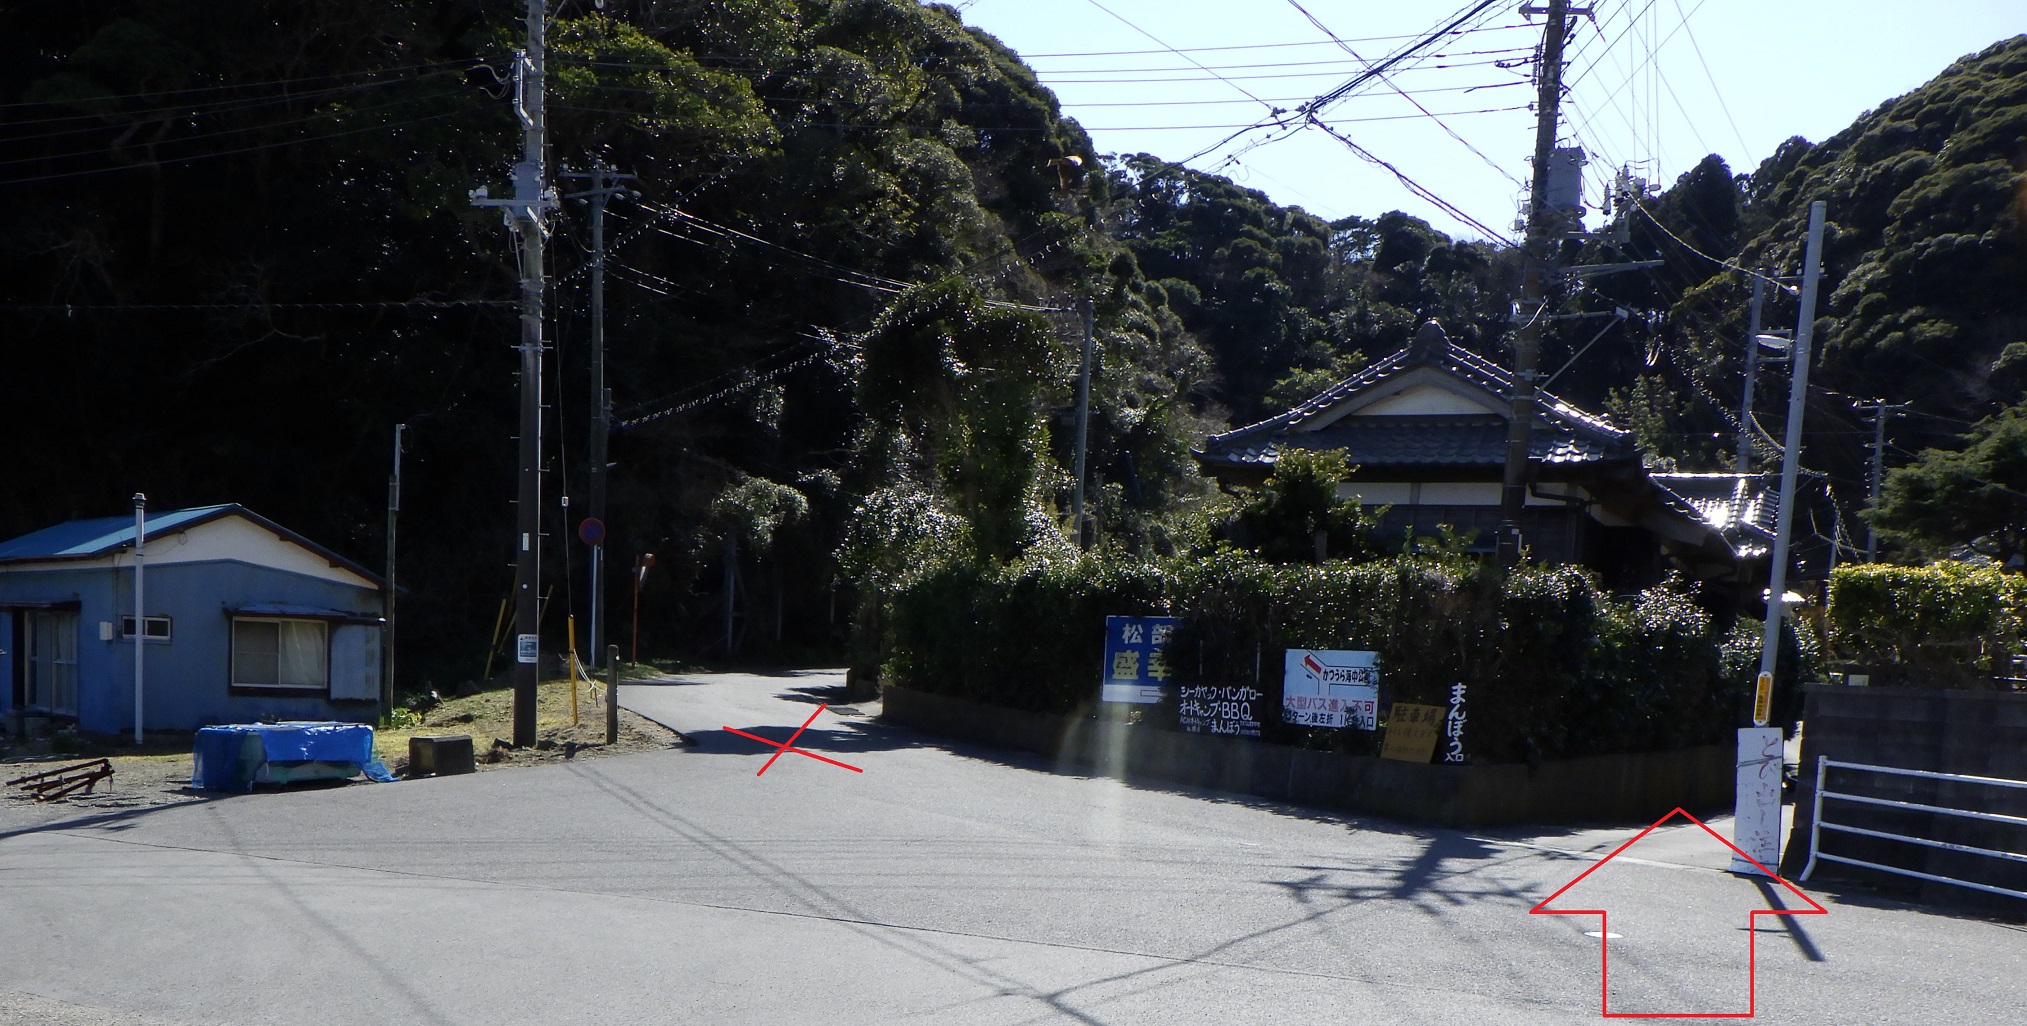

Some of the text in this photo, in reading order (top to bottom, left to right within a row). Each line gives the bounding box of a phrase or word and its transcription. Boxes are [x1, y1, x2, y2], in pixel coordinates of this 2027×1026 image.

[1286, 696, 1374, 714] 大型バス進入不可
[1211, 719, 1240, 735] まんぼう
[1448, 682, 1467, 755] まんぼう
[1445, 753, 1464, 762] 入口
